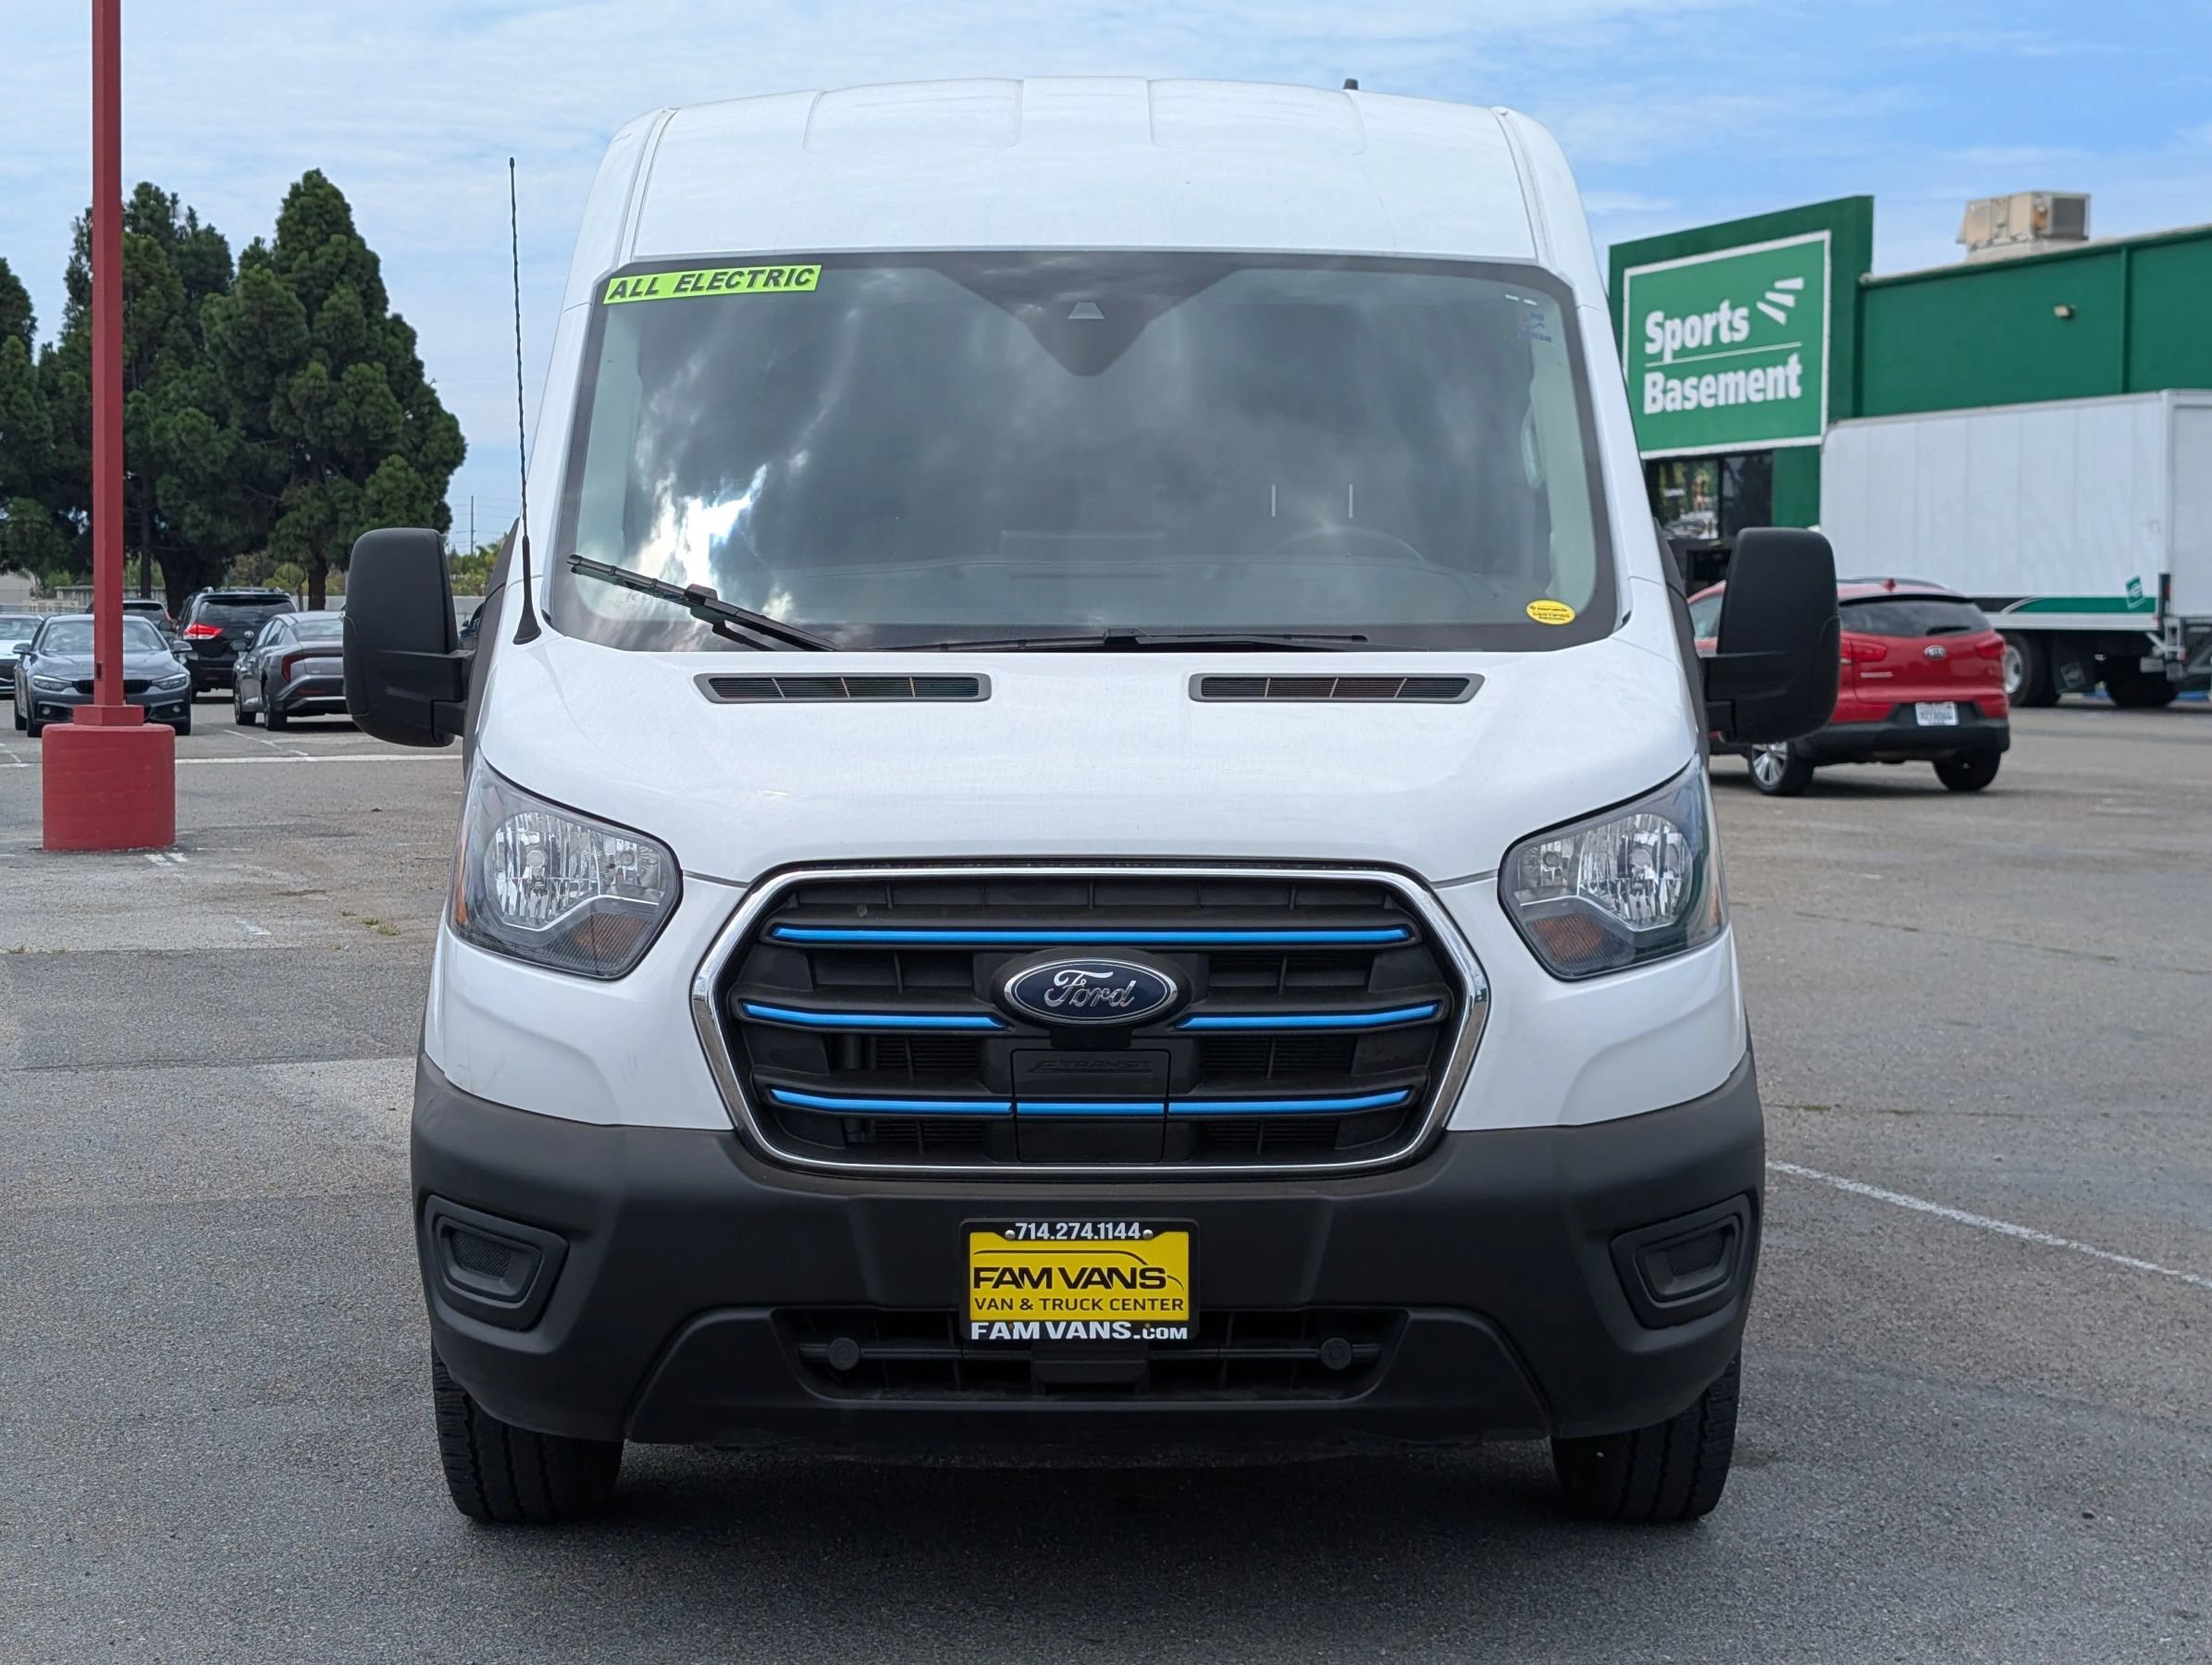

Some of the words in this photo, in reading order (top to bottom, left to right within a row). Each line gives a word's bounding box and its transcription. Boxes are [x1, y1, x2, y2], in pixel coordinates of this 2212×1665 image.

[607, 277, 660, 301] ALL
[673, 267, 816, 295] ELECTRIC
[1644, 299, 1749, 364] Sports
[1643, 352, 1802, 414] Basement
[1044, 968, 1137, 1007] Ford
[1015, 1222, 1141, 1240] 714.274.1144
[973, 1266, 1053, 1289] FAM
[1057, 1266, 1167, 1289] VANS
[974, 1298, 1014, 1311] VAN
[1019, 1298, 1034, 1311] &
[1039, 1298, 1104, 1311] TRUCK
[1109, 1297, 1184, 1311] CENTER
[971, 1321, 1041, 1340] FAM
